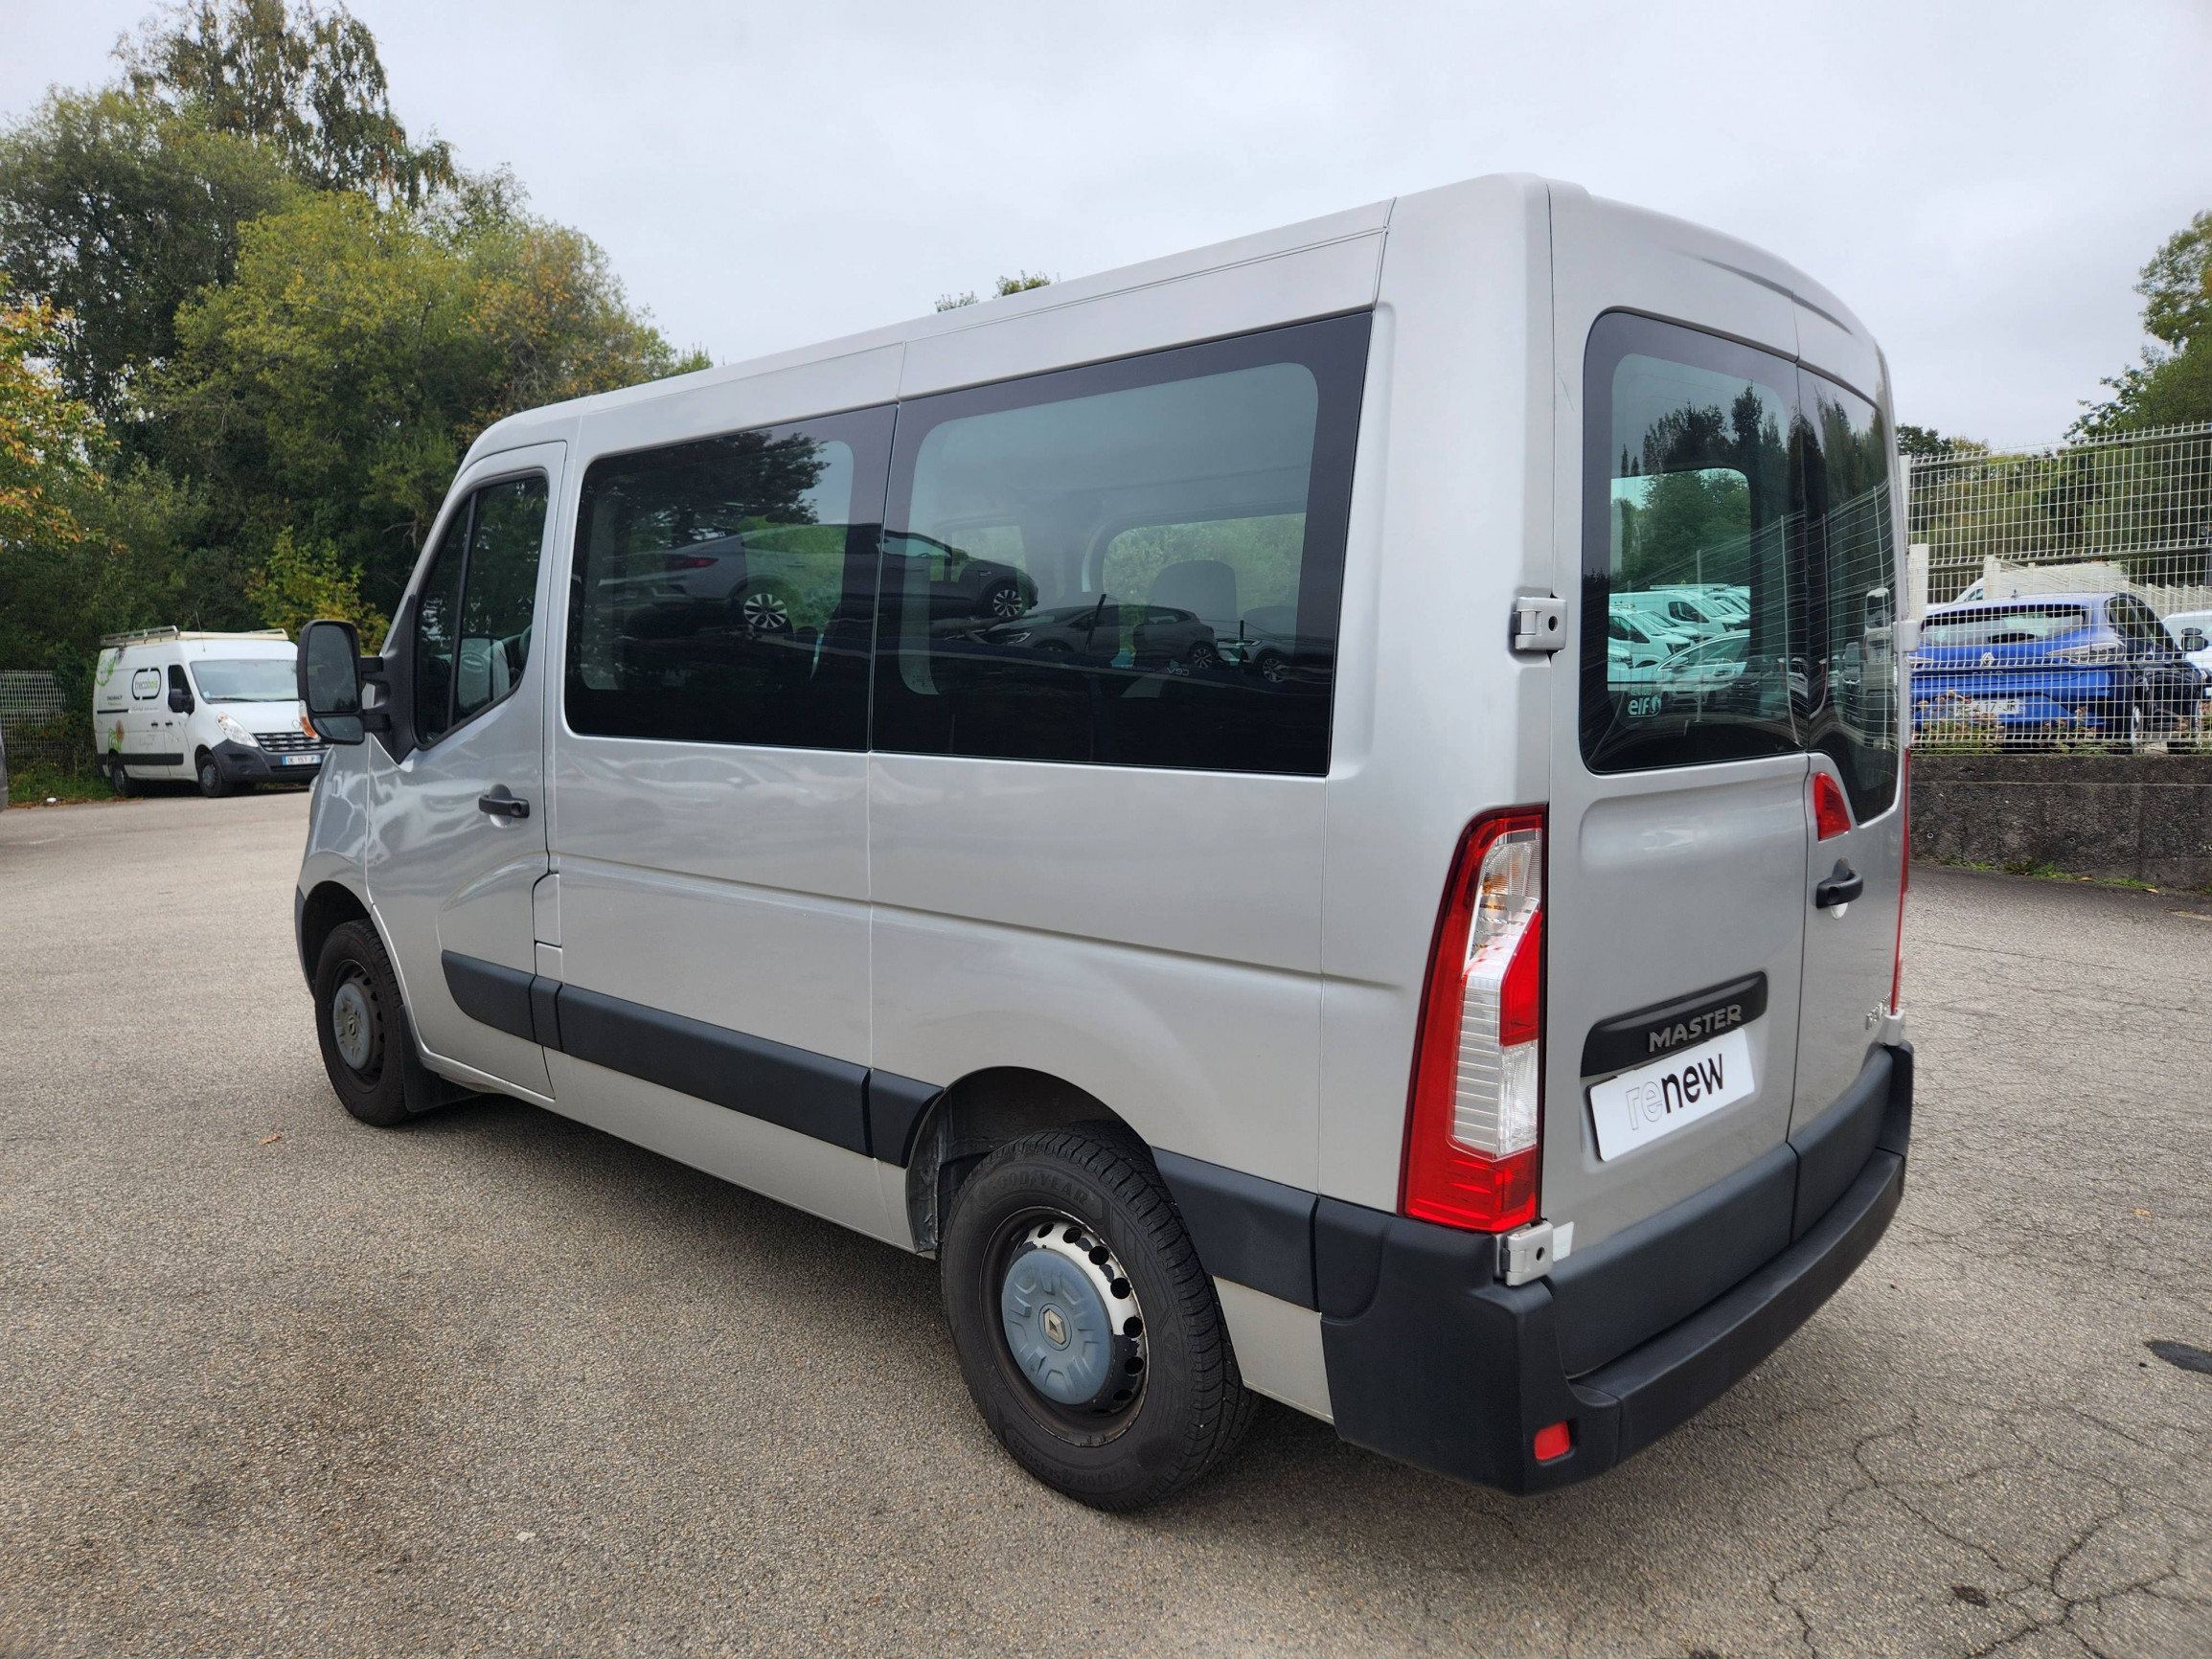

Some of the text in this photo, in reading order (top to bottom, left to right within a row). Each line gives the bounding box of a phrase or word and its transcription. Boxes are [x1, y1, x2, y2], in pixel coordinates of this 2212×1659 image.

[1628, 696, 1651, 716] elf
[1649, 1003, 1743, 1054] MASTER
[1626, 1053, 1724, 1131] renew
